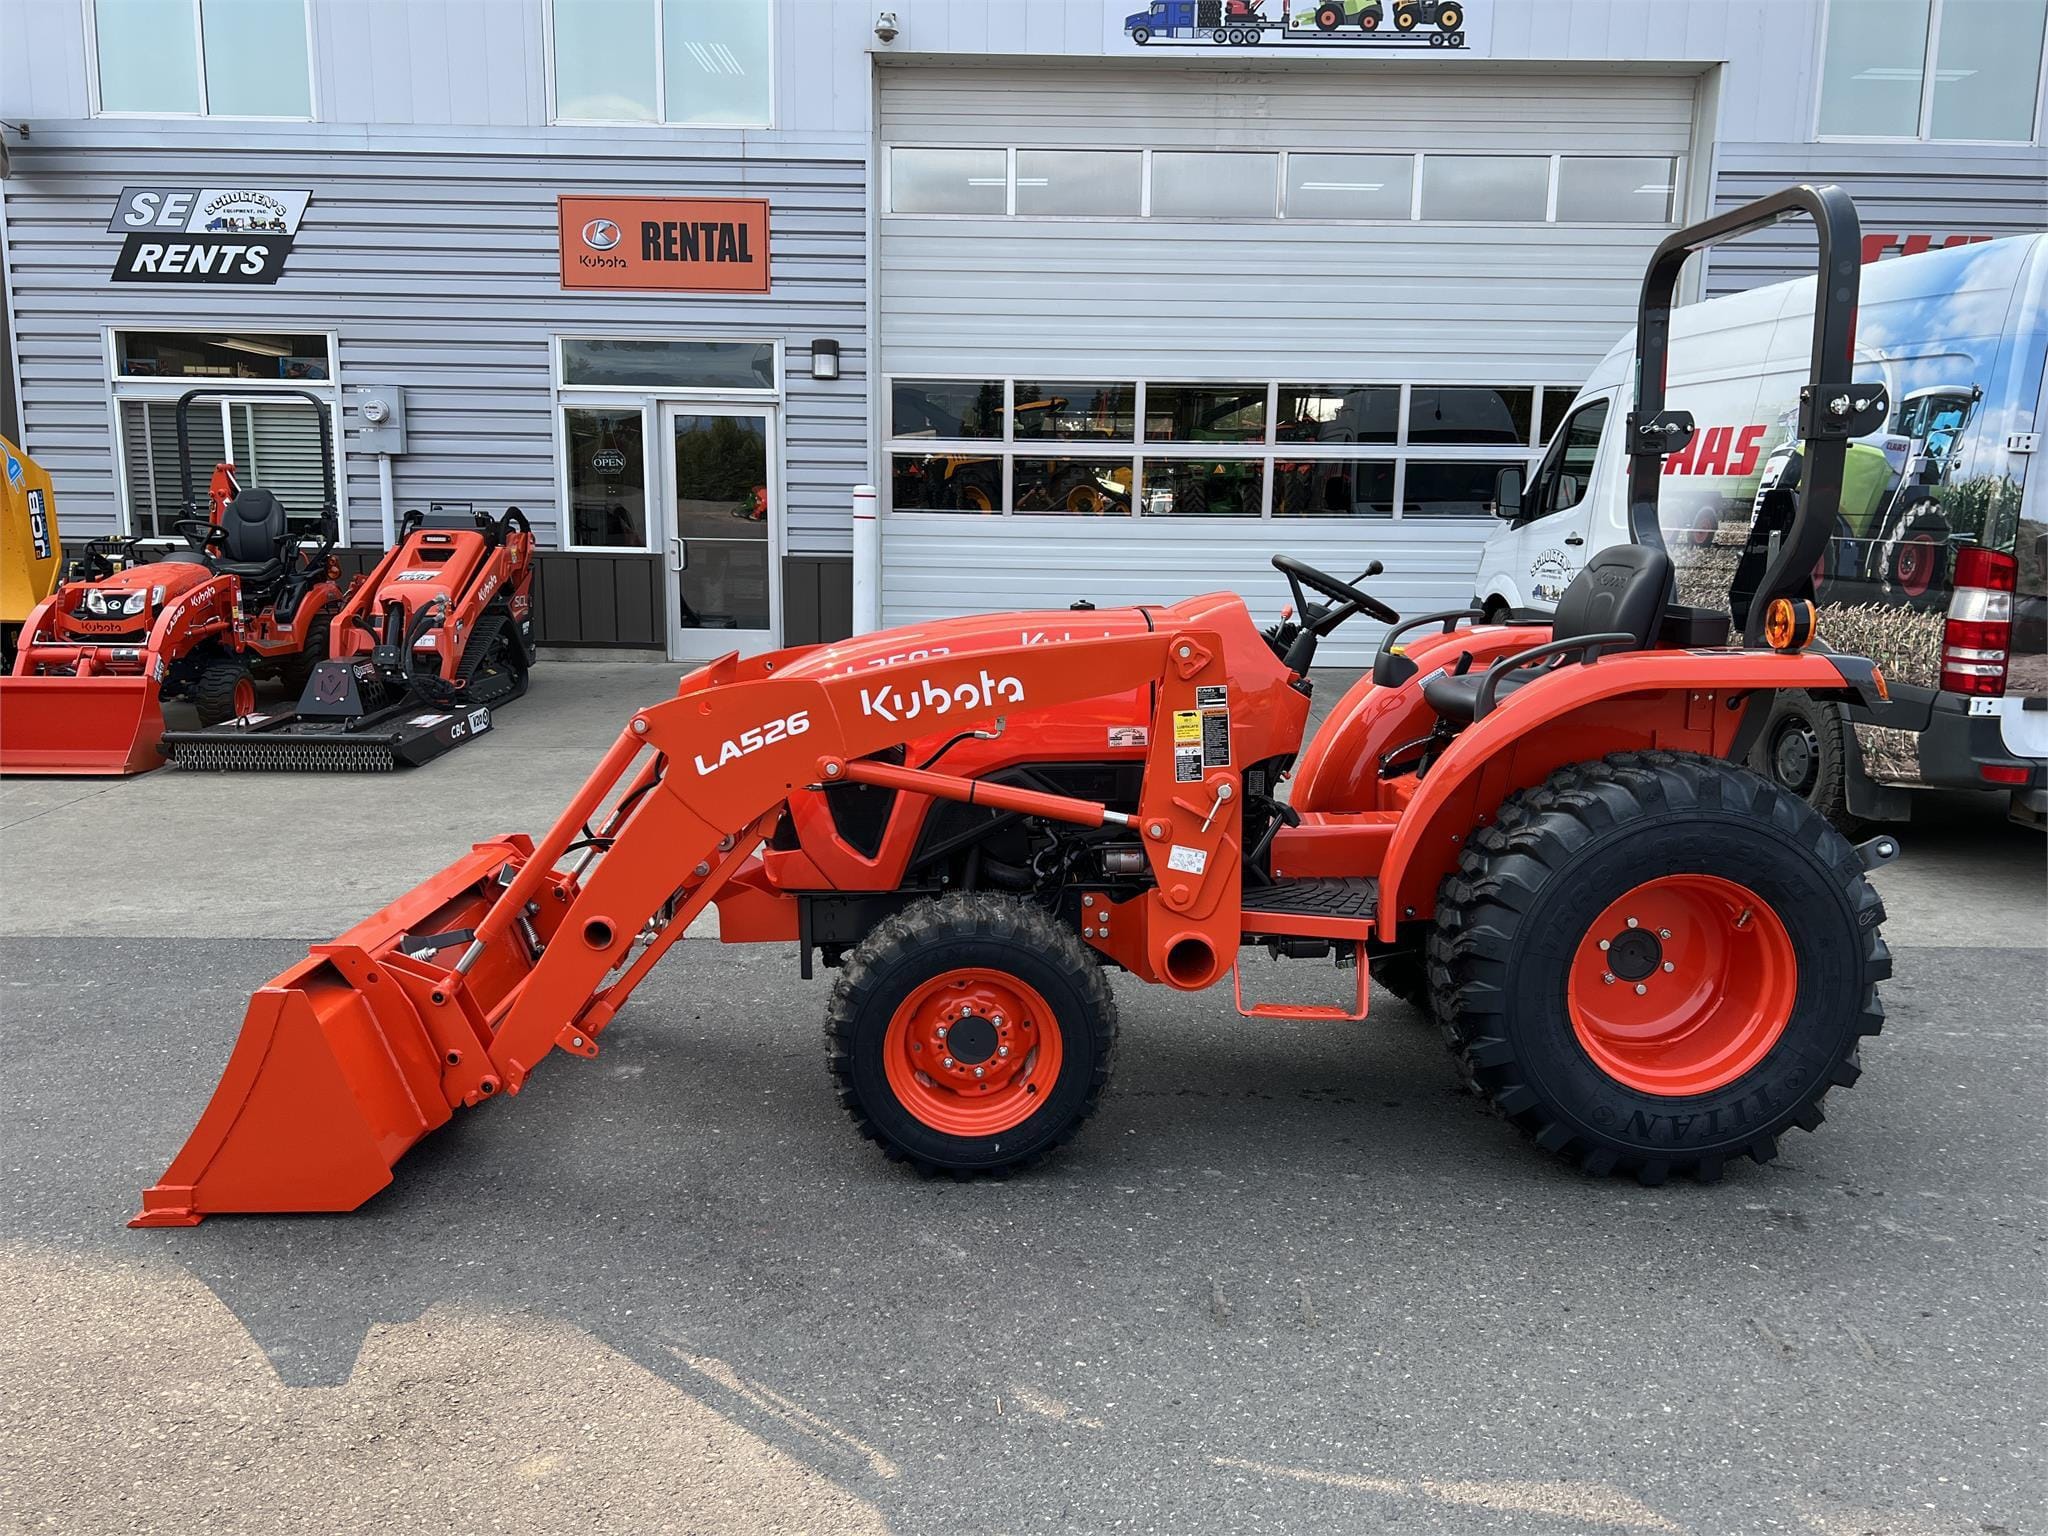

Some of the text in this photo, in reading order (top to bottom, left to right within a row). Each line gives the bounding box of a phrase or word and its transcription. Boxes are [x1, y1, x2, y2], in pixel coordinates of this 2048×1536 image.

[124, 192, 195, 227] SE
[204, 190, 287, 216] SCHOLTEN'S
[131, 243, 269, 275] RENTS
[641, 221, 753, 263] RENTAL
[579, 255, 628, 268] Kubota
[593, 458, 624, 467] OPEN
[1626, 425, 1767, 476] AAS
[28, 491, 46, 558] JCB
[1530, 548, 1576, 583] SCHOLTEN'S
[190, 586, 216, 607] Kubota
[478, 575, 498, 601] Kubota
[81, 622, 122, 632] Kubota
[860, 670, 1025, 722] Kubota
[694, 710, 811, 776] LA526
[1618, 1083, 1782, 1141] TITAN
